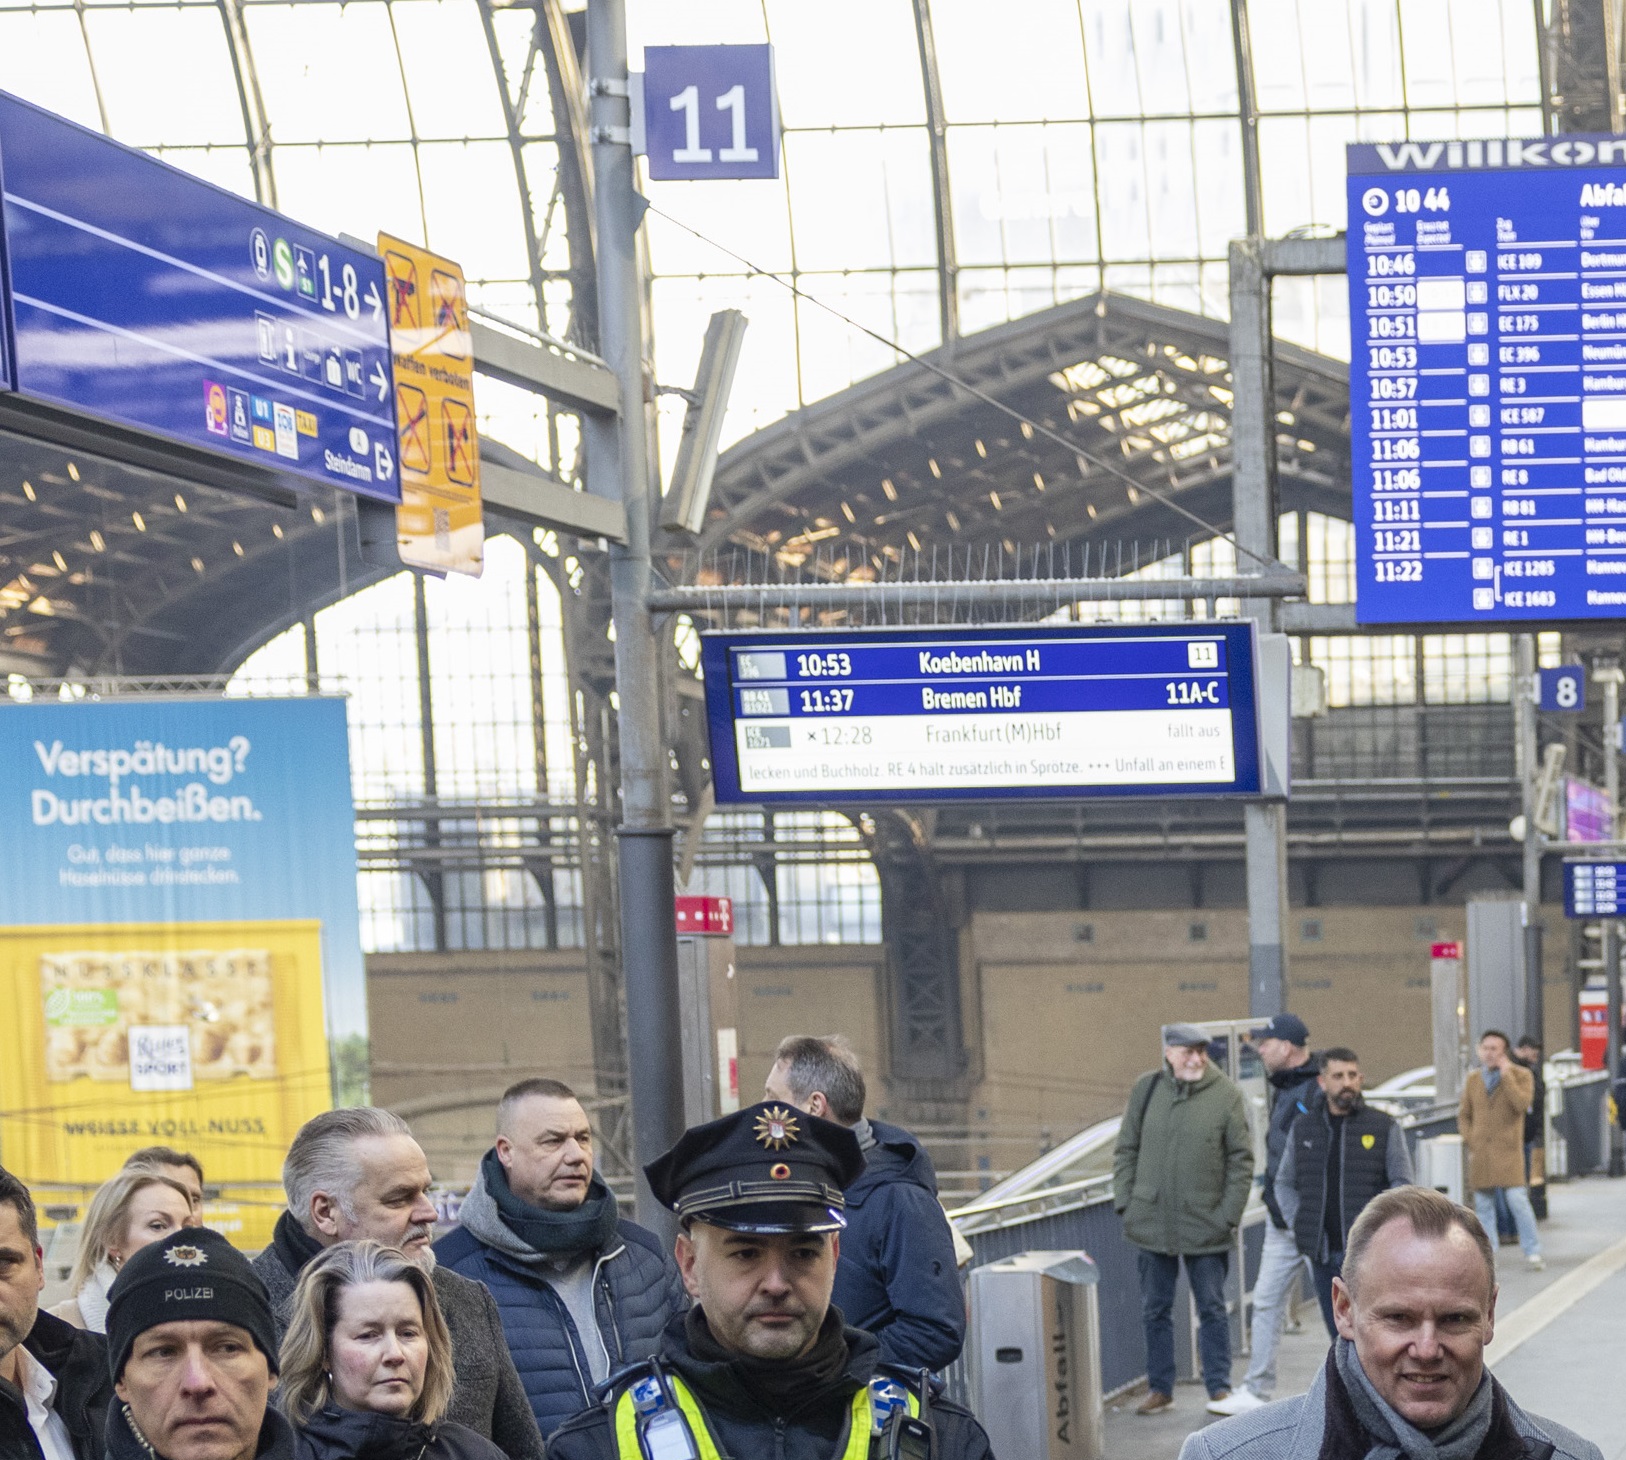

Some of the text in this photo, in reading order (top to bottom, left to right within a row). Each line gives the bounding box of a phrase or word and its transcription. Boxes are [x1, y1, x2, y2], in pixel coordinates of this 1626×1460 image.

[669, 85, 760, 163] 11
[1367, 253, 1415, 276] 10:46
[274, 240, 361, 321] S 1-8
[1367, 284, 1416, 307] 10:50
[1368, 315, 1416, 338] 10:51
[1369, 346, 1417, 368] 10:53
[347, 361, 362, 385] WC
[1369, 376, 1417, 399] 10:57
[255, 400, 269, 419] U1
[1370, 407, 1418, 430] 11:01
[297, 413, 317, 433] TAXI
[257, 430, 271, 446] U3
[324, 450, 373, 482] Steindamm
[1375, 560, 1422, 582] 11:22
[798, 654, 851, 676] 10:53
[920, 650, 1040, 673] Koebenhavn H
[1195, 647, 1211, 661] 11
[801, 690, 853, 711] 11:37
[922, 686, 1021, 709] Bremen Hbf
[1167, 682, 1219, 704] 11A-C
[1556, 676, 1577, 708] 8
[821, 725, 873, 746] 12:28
[1198, 726, 1220, 738] aus
[33, 735, 251, 783] Verspätung?
[794, 765, 818, 779] und
[888, 763, 905, 777] RE
[907, 763, 917, 776] 4
[948, 759, 1013, 776] zusätzlich
[1015, 760, 1028, 774] in
[1115, 758, 1155, 773] Unfall
[1158, 760, 1174, 772] an
[1177, 758, 1216, 771] einem
[31, 782, 263, 826] Durchbeißen.
[145, 842, 177, 862] hier
[179, 844, 231, 867] ganze
[164, 1287, 215, 1302] POLIZEI
[1052, 1332, 1072, 1445] Abfall
